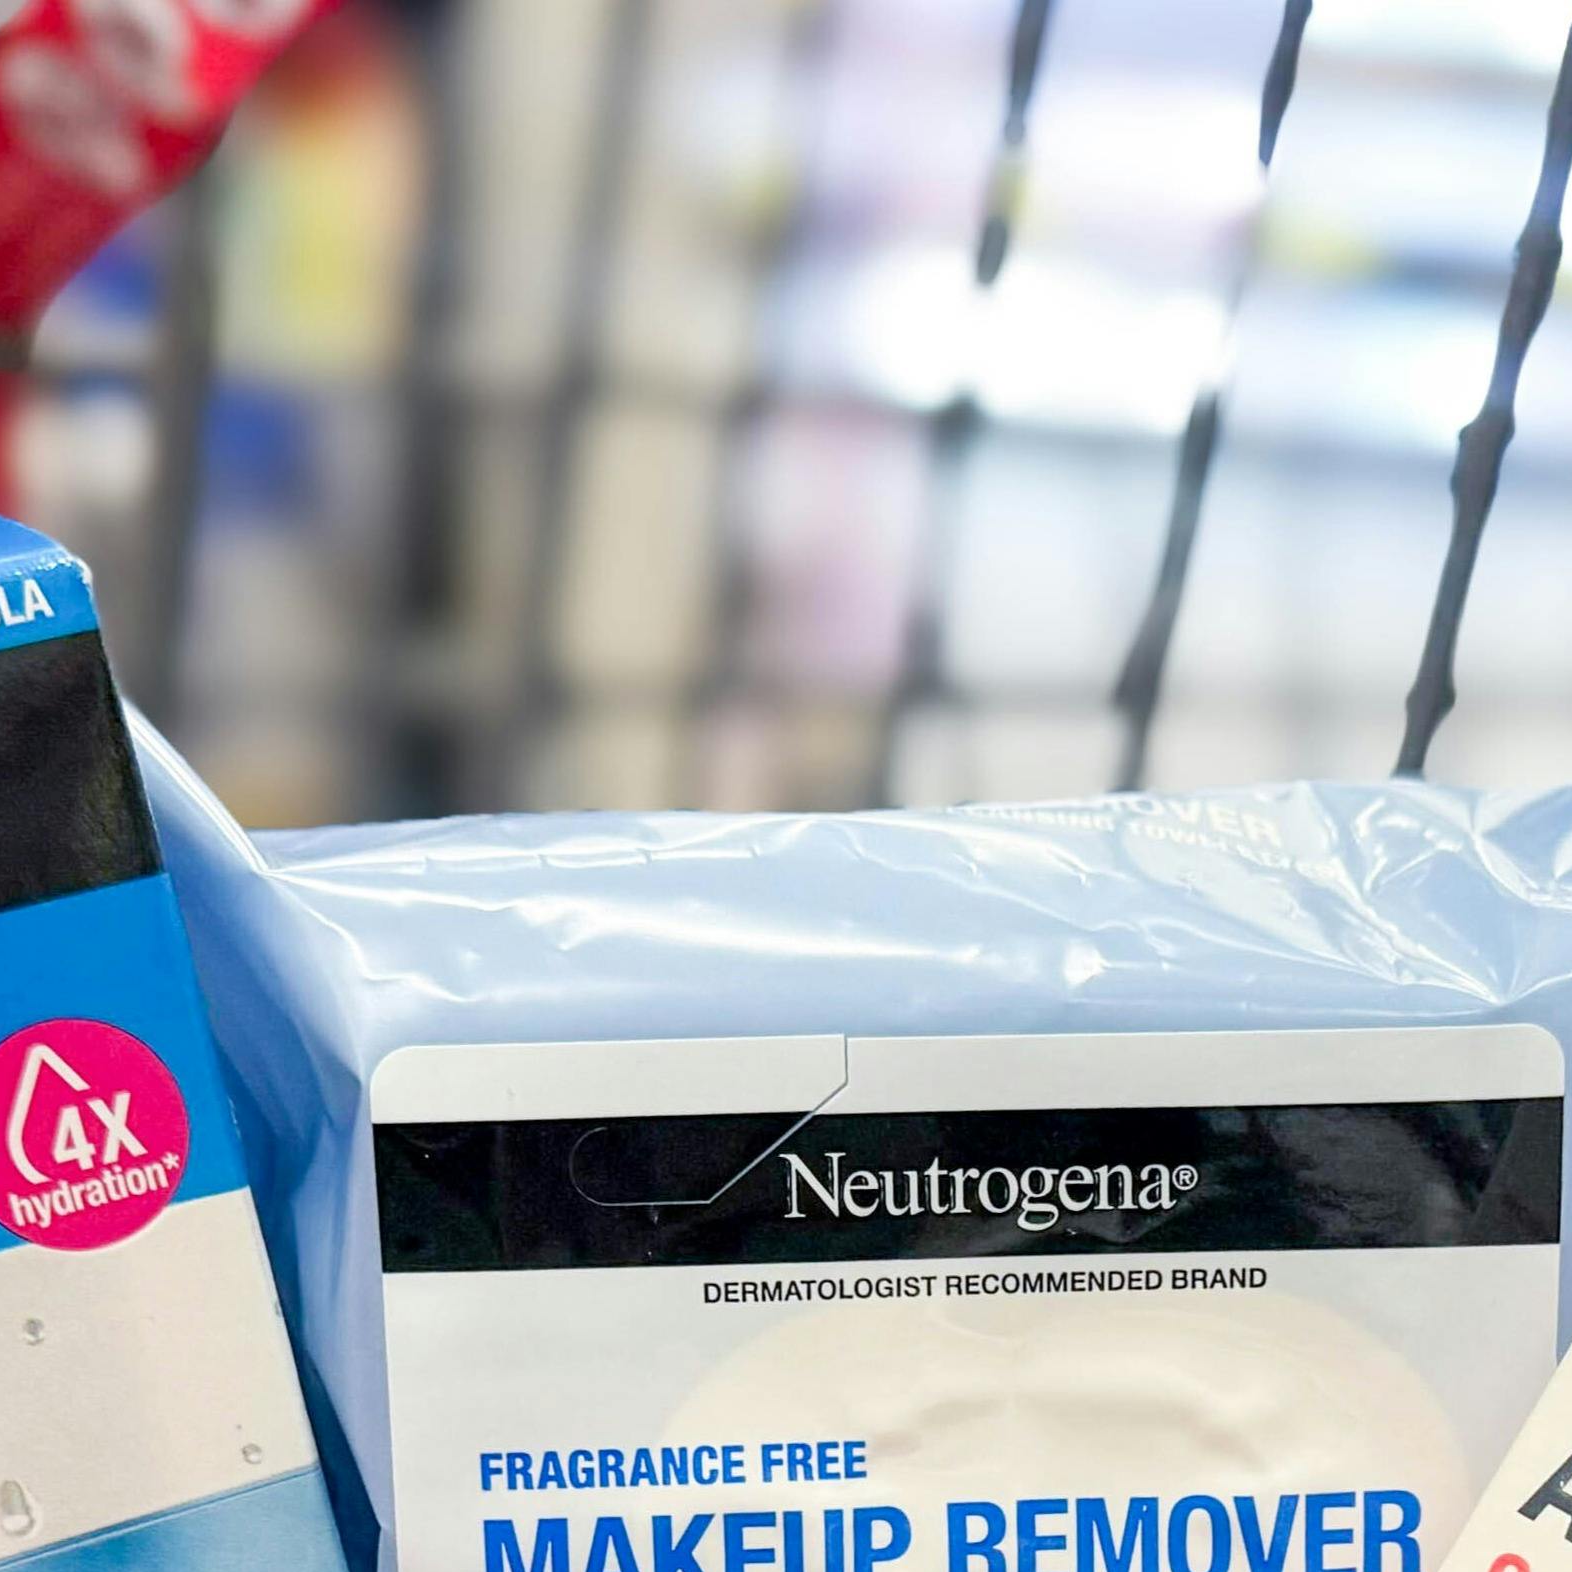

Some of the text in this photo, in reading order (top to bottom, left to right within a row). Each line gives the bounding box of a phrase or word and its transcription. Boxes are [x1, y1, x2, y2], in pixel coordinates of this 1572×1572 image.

[780, 1152, 1198, 1231] Neutrogena®
[703, 1267, 1268, 1304] DERMATOLOGIST RECOMMENDED BRAND
[480, 1440, 867, 1491] FRAGRANCE FREE
